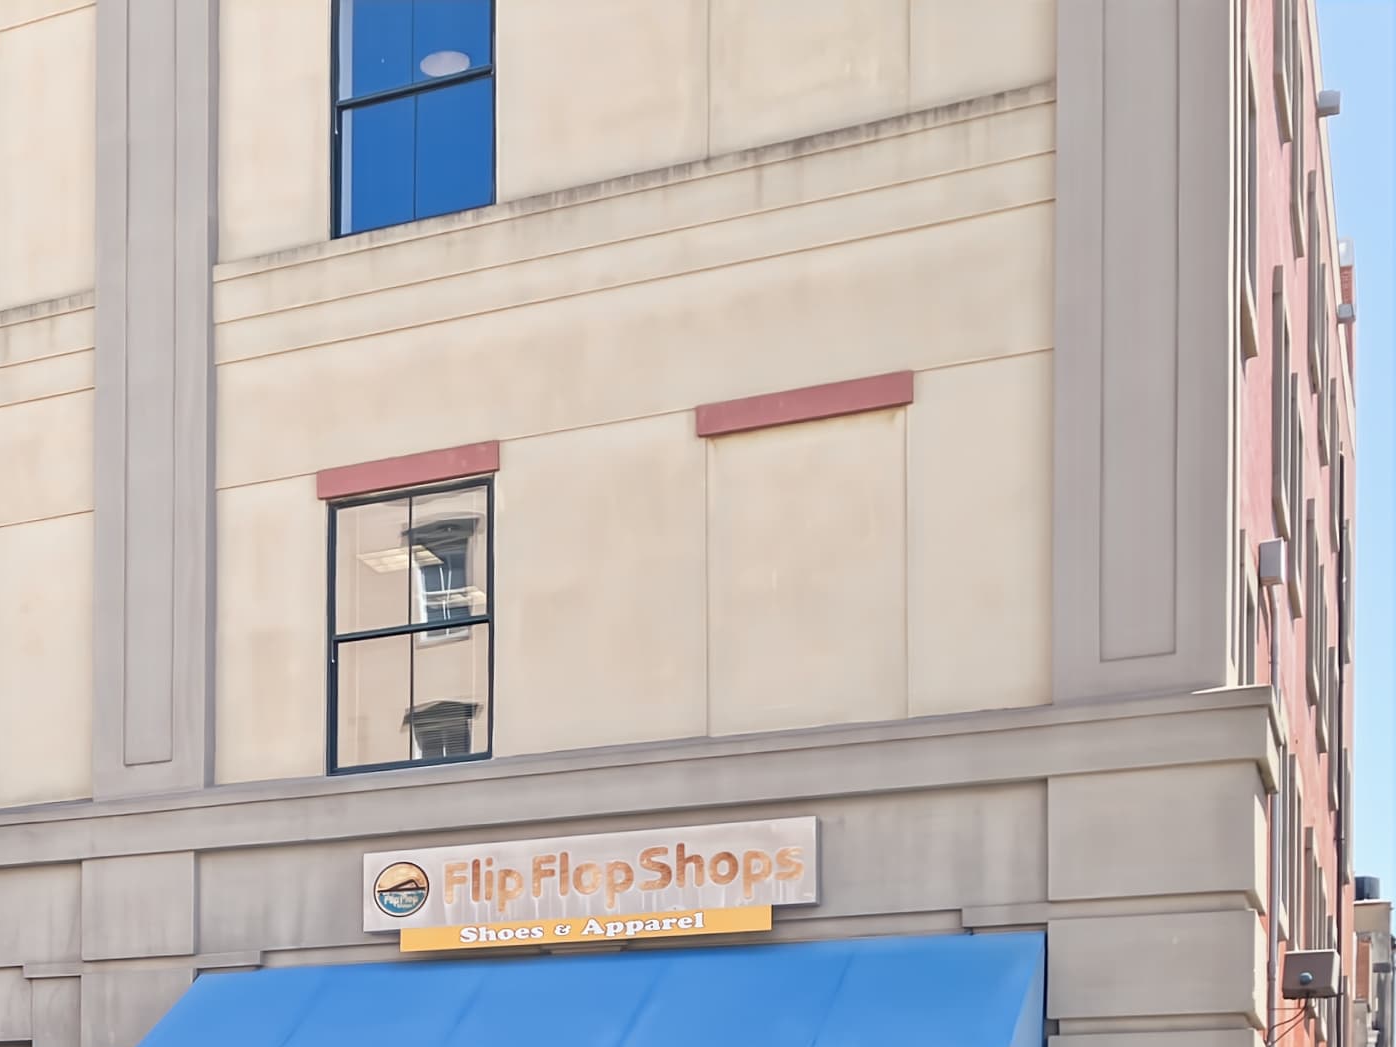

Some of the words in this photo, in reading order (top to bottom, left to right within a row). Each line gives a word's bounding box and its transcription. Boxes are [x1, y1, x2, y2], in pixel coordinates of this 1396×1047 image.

[443, 856, 524, 912] Flip
[532, 850, 635, 909] Flop
[638, 842, 804, 899] Shops
[459, 924, 544, 943] Shoes
[554, 923, 572, 937] &
[582, 911, 705, 940] Apparel
